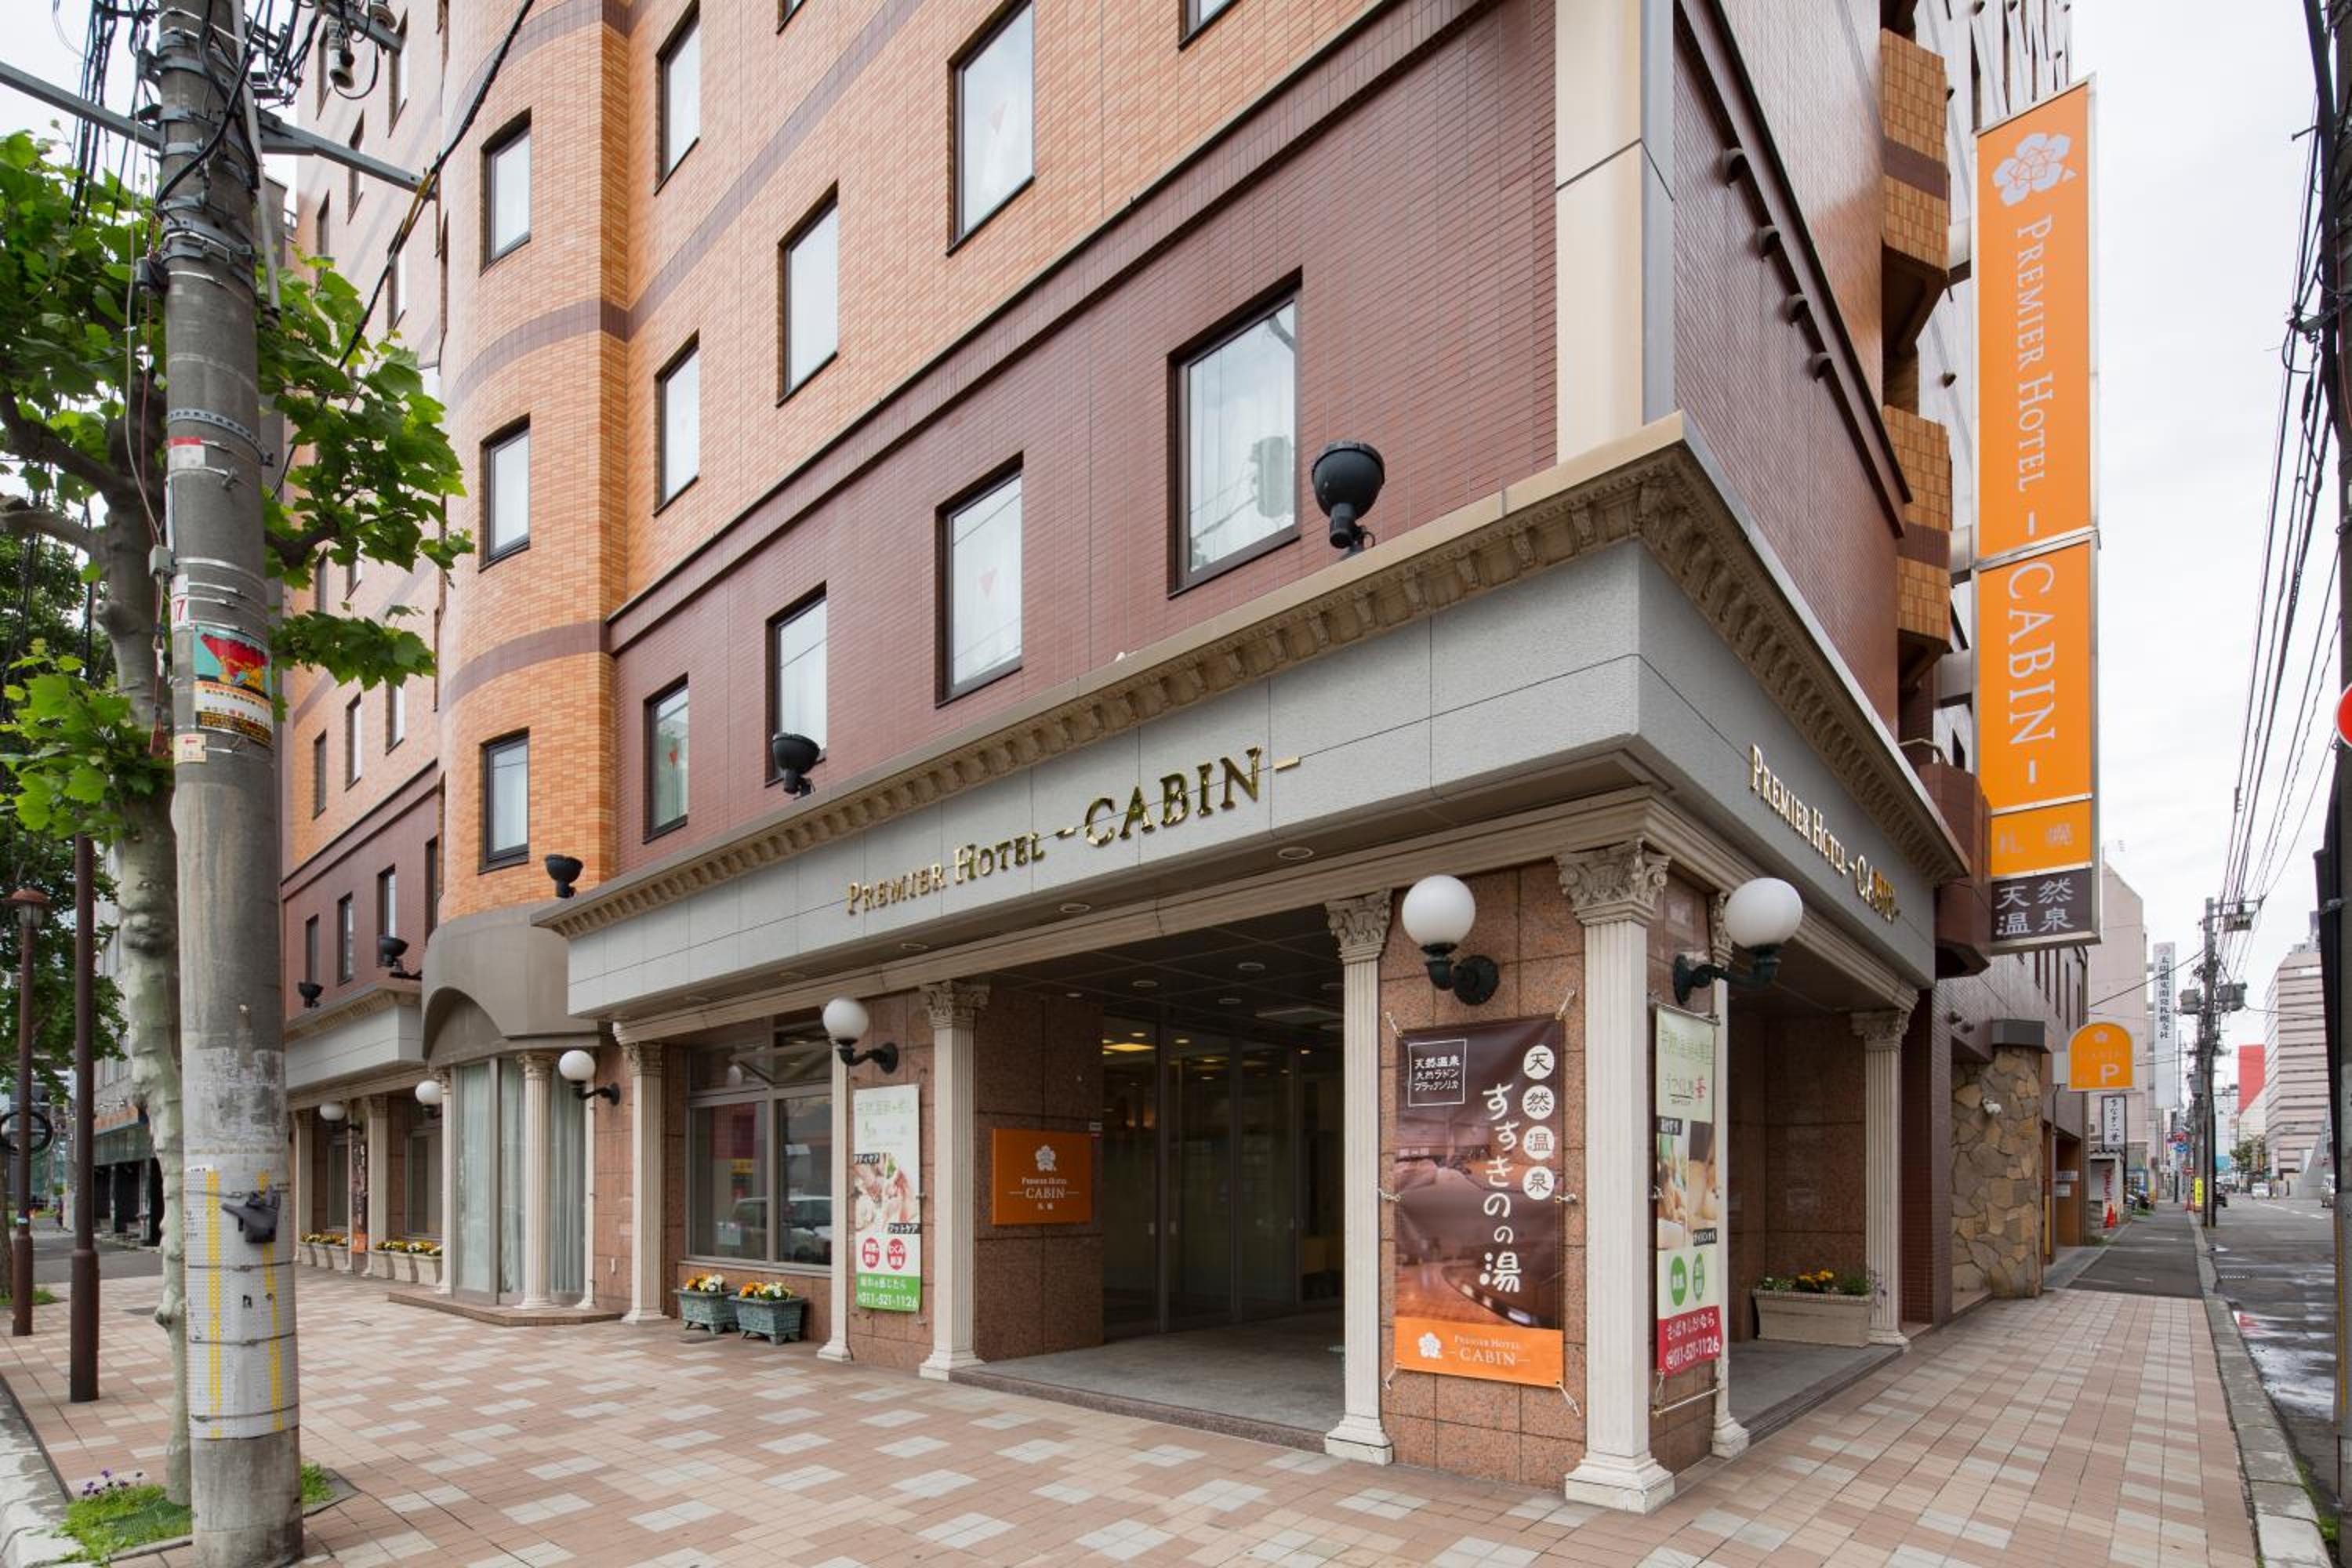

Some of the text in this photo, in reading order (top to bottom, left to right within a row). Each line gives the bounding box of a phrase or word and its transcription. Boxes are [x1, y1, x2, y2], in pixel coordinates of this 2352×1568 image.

[2016, 214, 2052, 371] PREMIER
[2018, 372, 2053, 492] HOTEL
[176, 599, 185, 621] 7
[1750, 742, 1811, 840] PREMIER
[1811, 806, 1847, 876] HOTEL
[846, 862, 946, 915] PREMIER
[953, 832, 1046, 884] HOTEL
[1995, 907, 2074, 937] 温泉
[1996, 877, 2074, 910] 天然
[1524, 1047, 1553, 1197] 天然温泉
[2100, 1063, 2121, 1086] P
[1479, 1083, 1522, 1293] すすきのの湯
